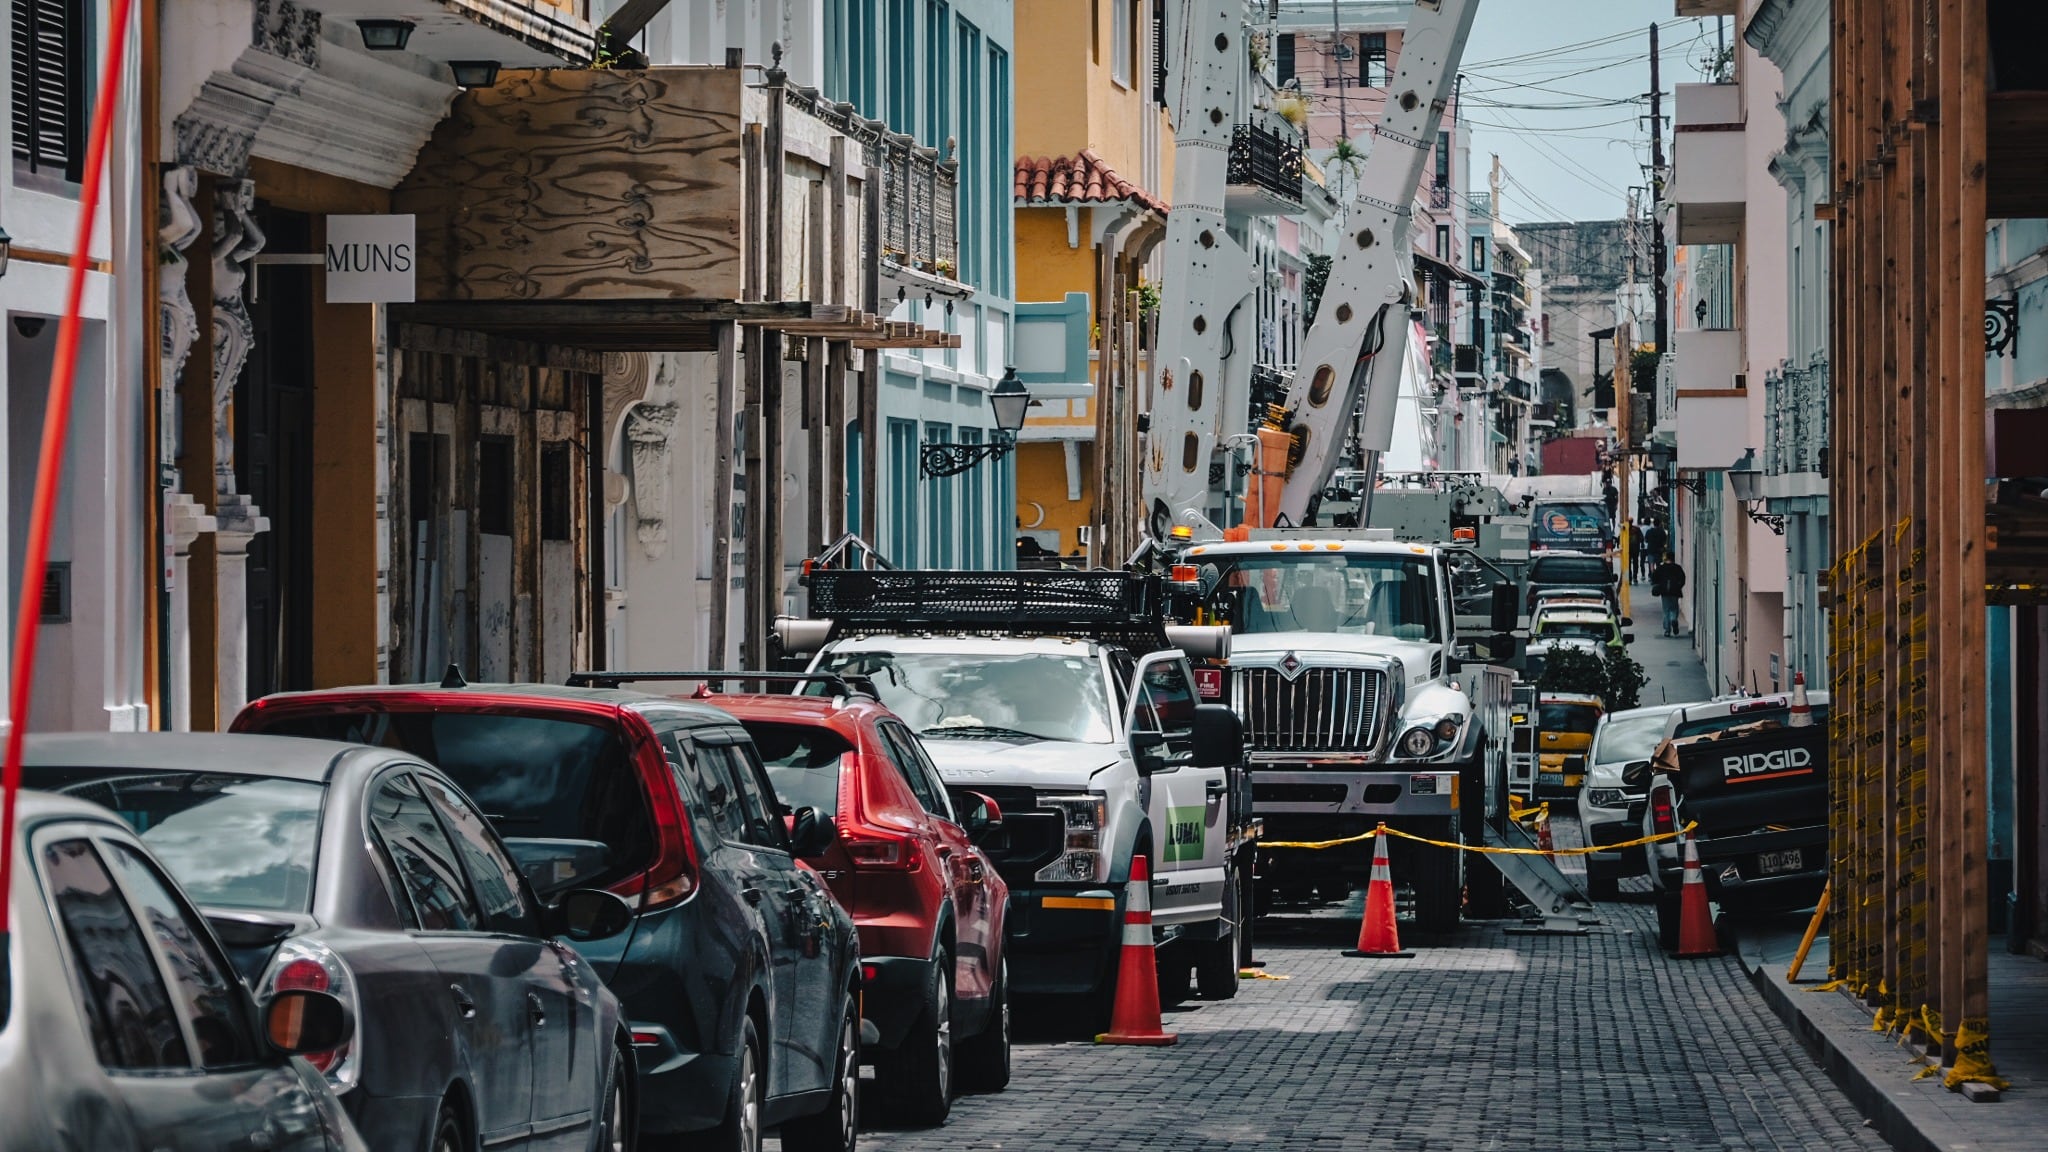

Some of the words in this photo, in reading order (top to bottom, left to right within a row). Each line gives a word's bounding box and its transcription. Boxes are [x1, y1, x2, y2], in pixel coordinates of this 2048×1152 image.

[327, 243, 411, 273] MUNS
[1723, 747, 1811, 776] RIDGID
[1169, 823, 1200, 845] LUMA
